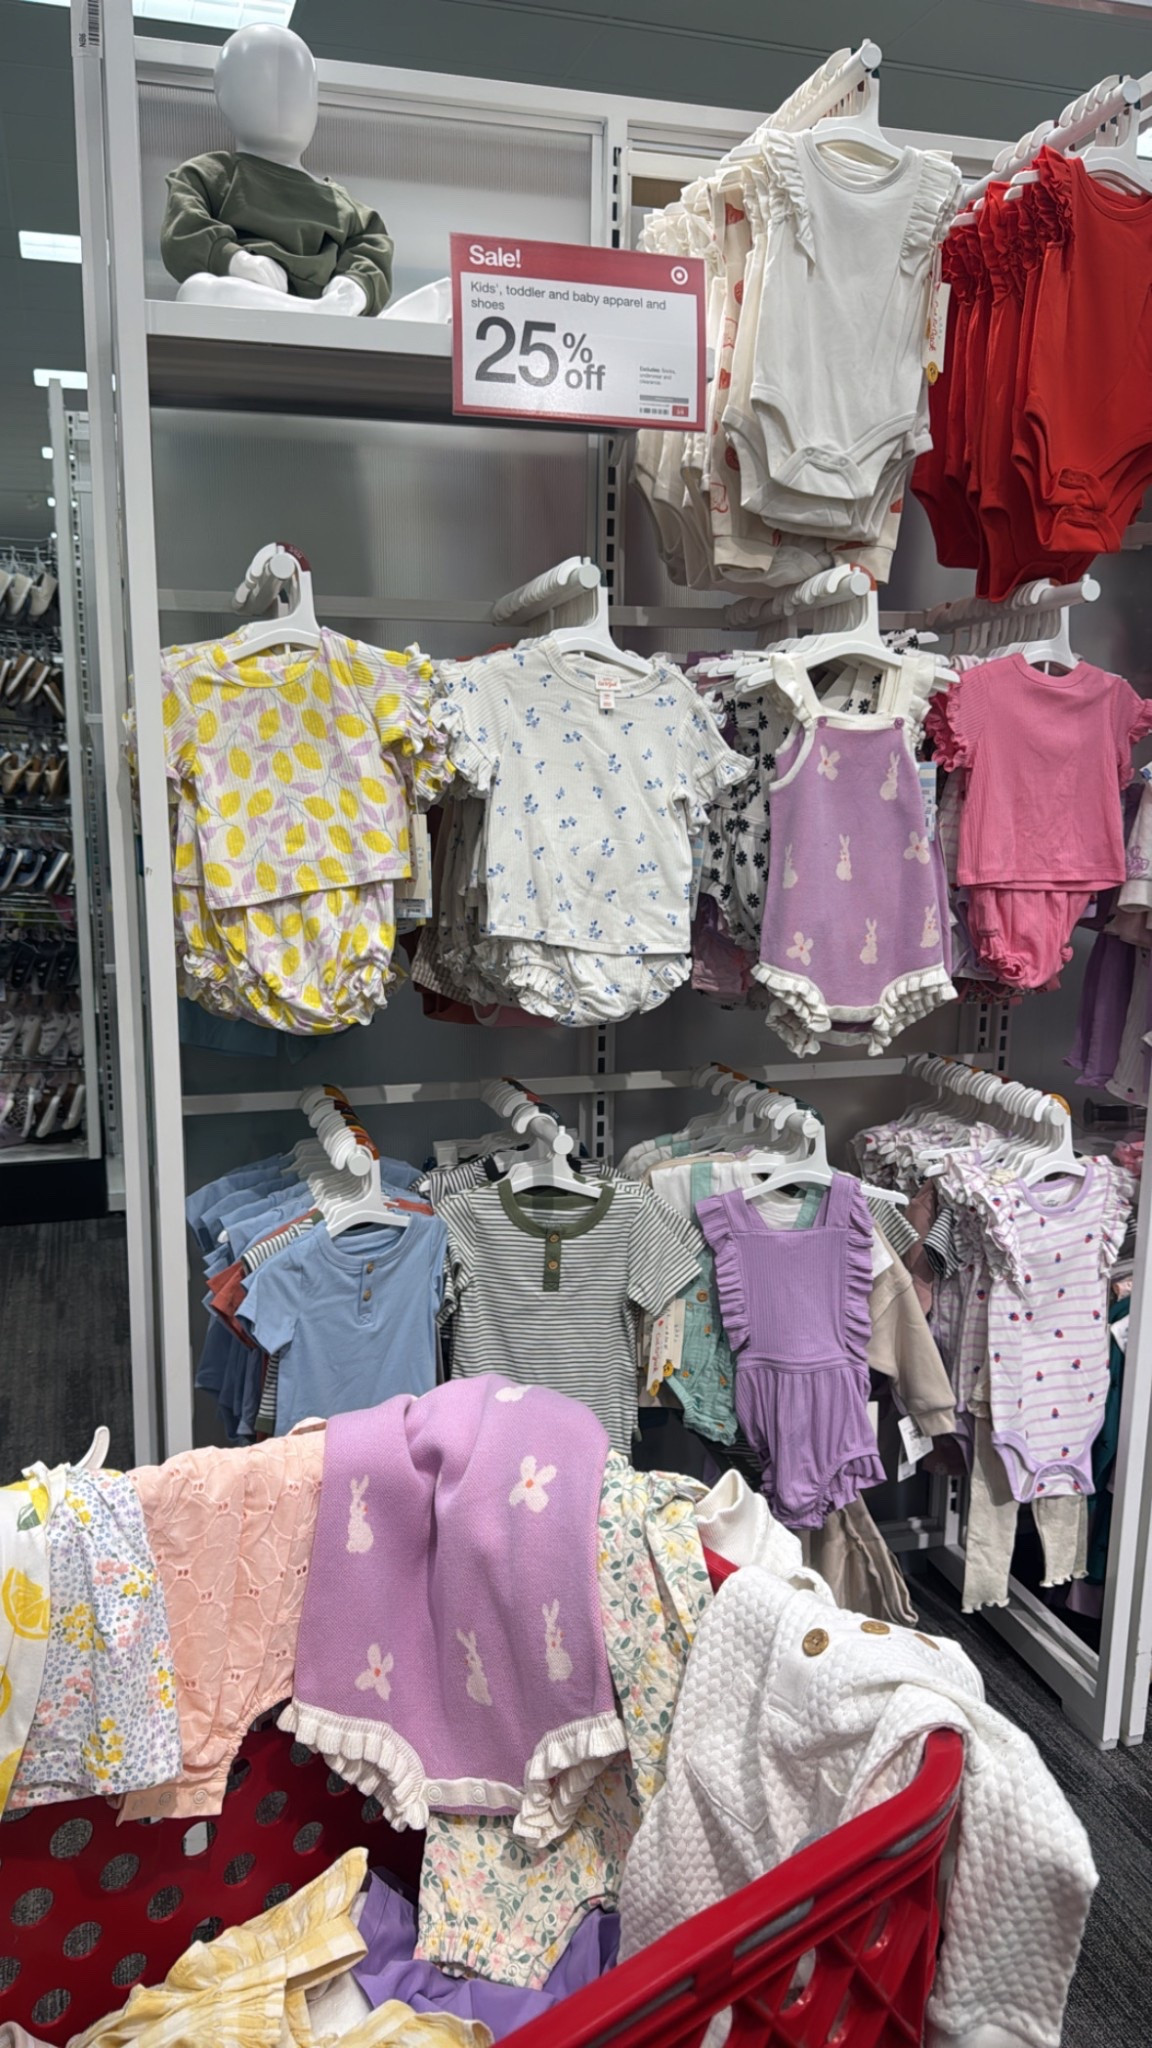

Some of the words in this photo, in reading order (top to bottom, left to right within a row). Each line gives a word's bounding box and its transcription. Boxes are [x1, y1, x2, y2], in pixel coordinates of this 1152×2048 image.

[469, 244, 521, 269] Sale!
[470, 281, 502, 296] Kids',
[506, 285, 546, 299] toddler
[548, 290, 570, 301] and
[572, 291, 600, 306] baby
[603, 295, 643, 309] apparel
[646, 300, 667, 310] and
[471, 298, 505, 310] shoes
[475, 315, 560, 387] 25
[562, 332, 593, 364] %
[565, 363, 606, 391] off
